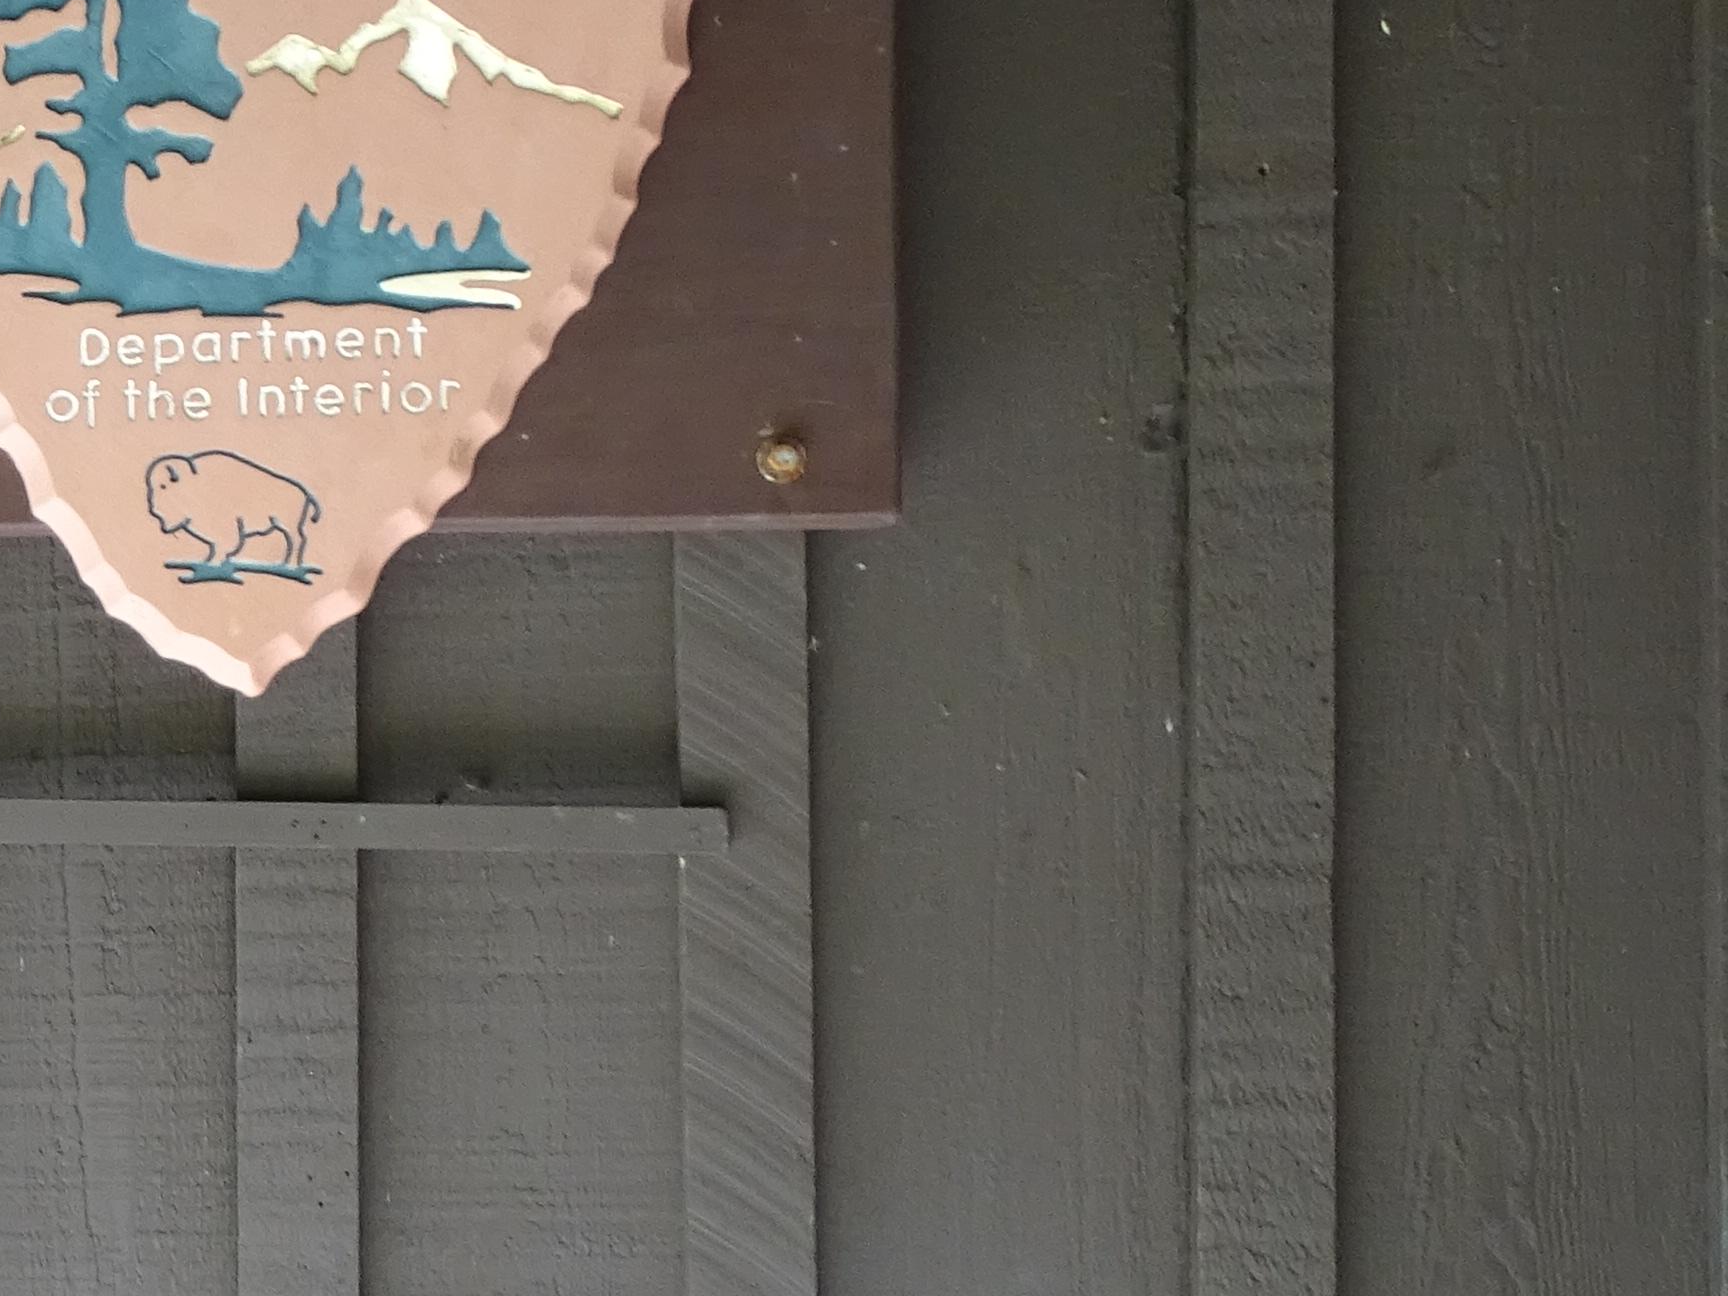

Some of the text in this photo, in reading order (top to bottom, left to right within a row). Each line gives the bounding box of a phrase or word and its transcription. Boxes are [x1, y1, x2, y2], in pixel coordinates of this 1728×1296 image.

[78, 316, 429, 375] Department
[44, 375, 462, 428] of the Interior
